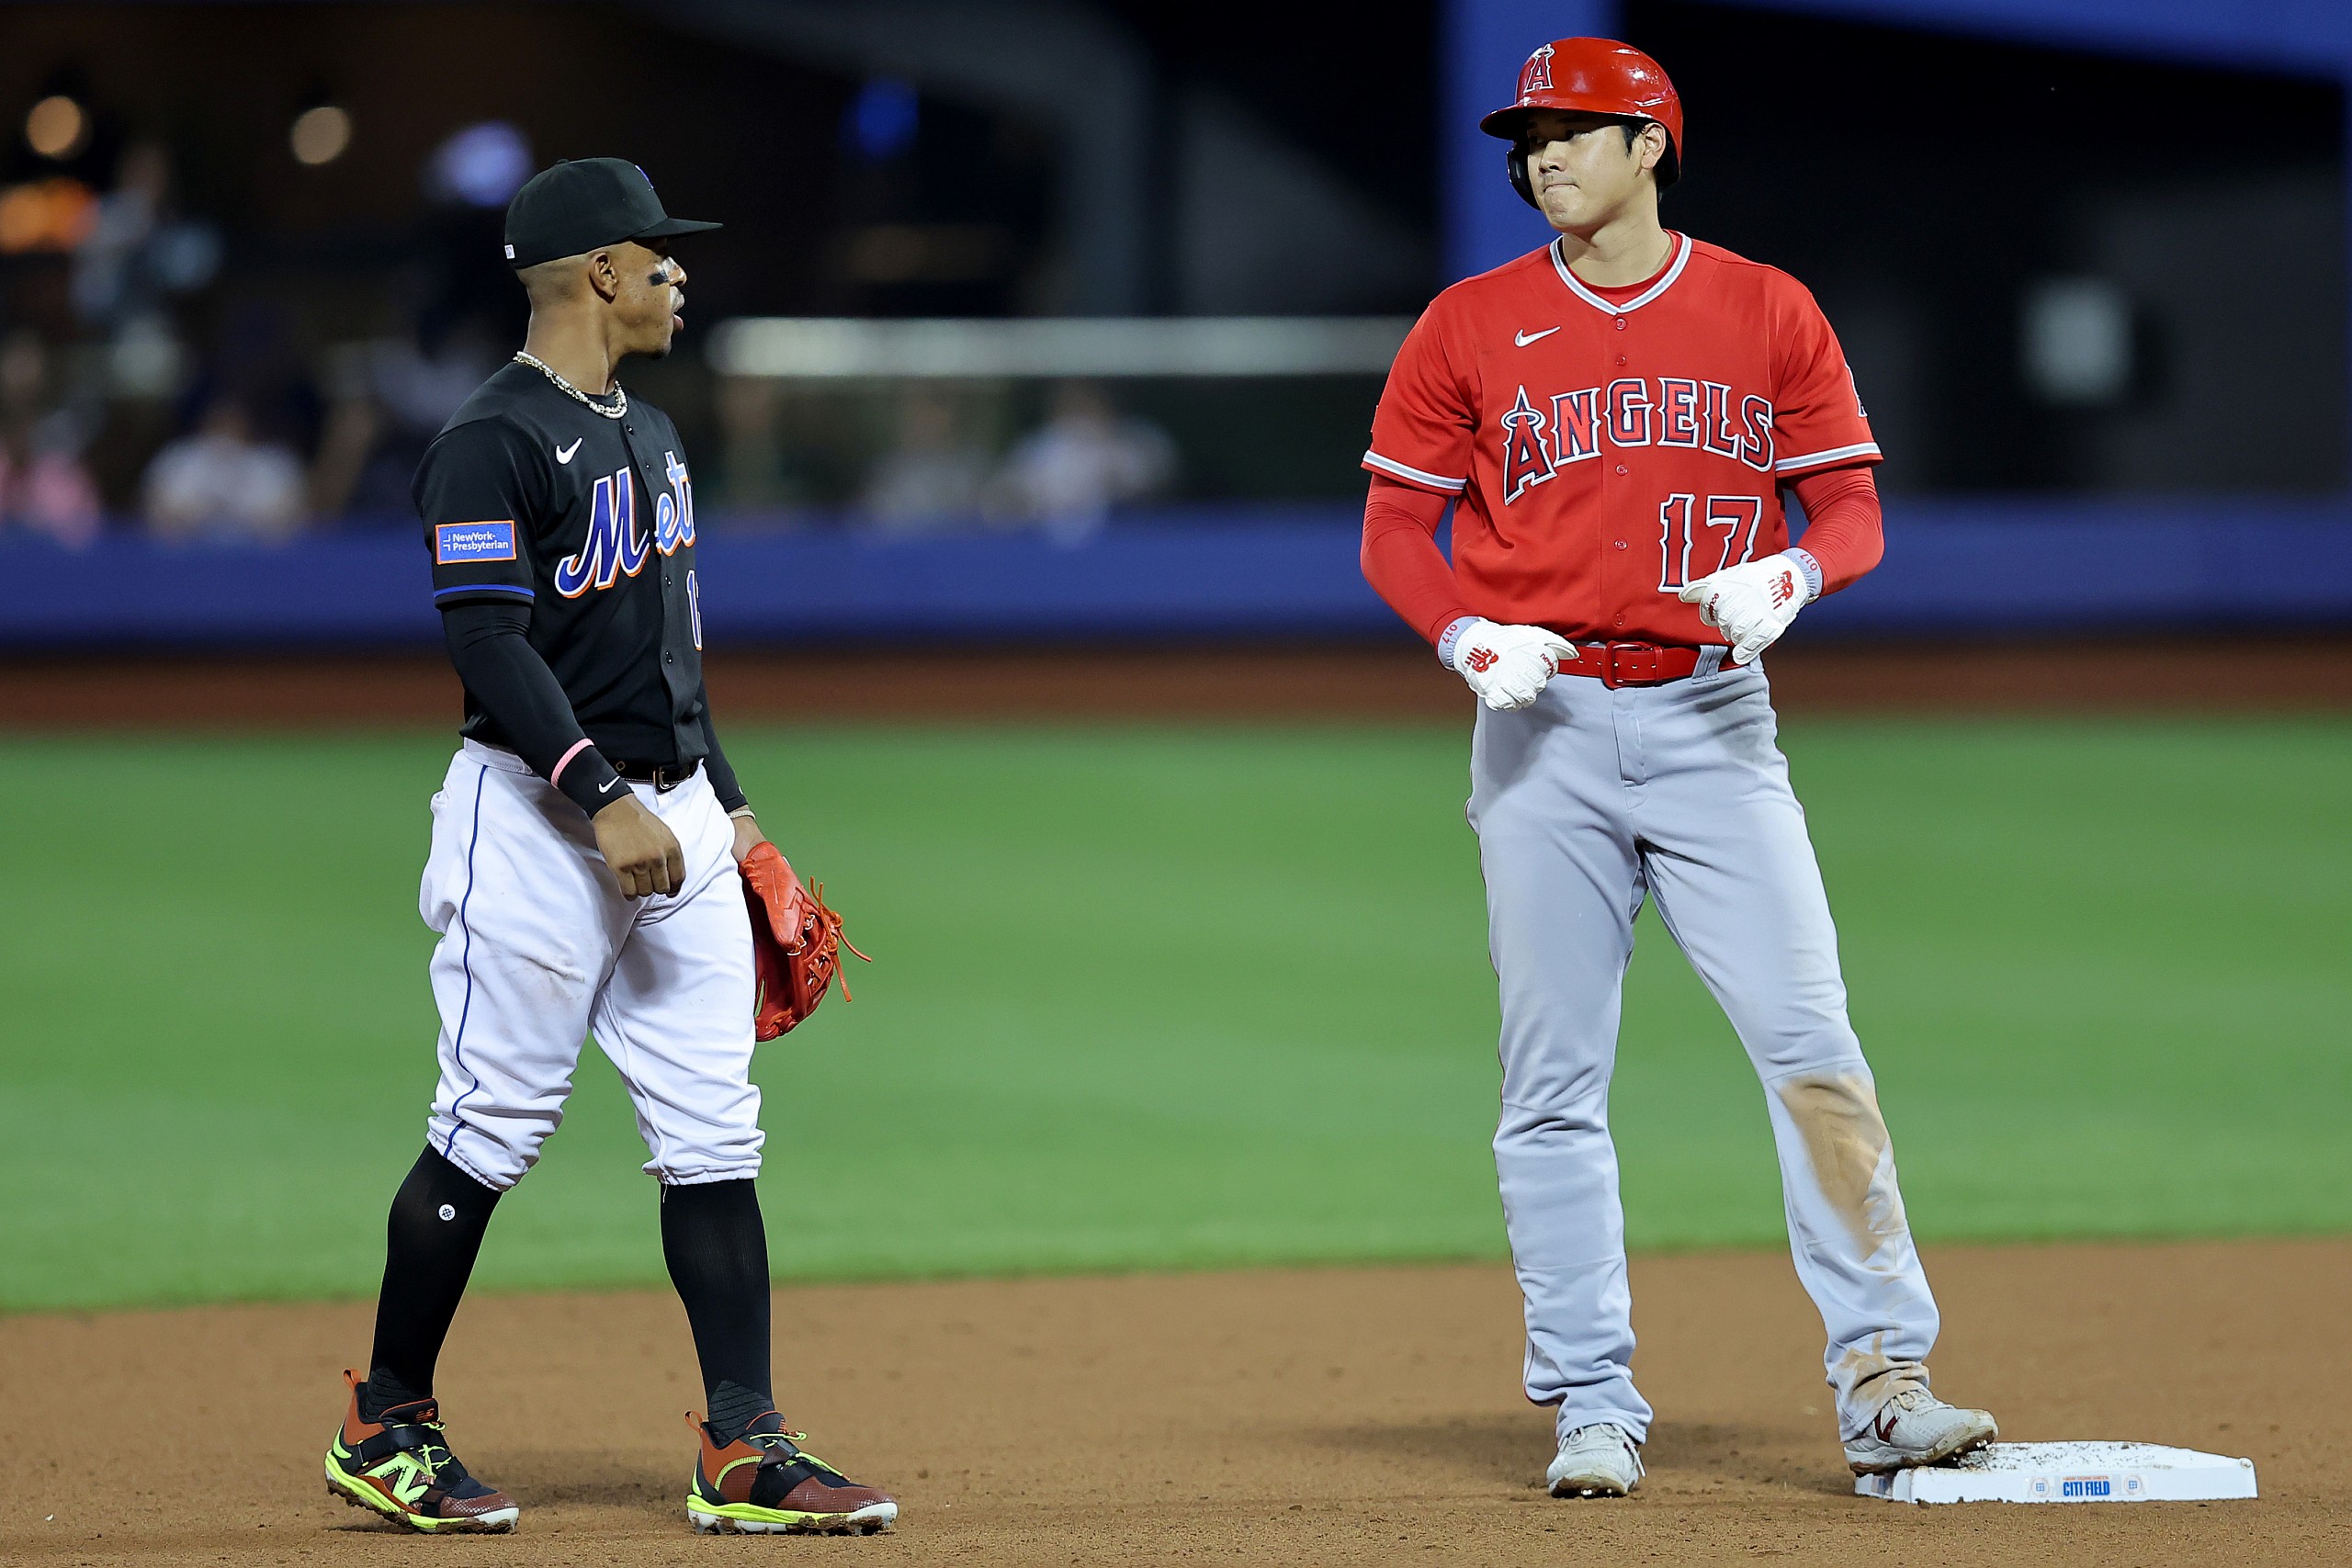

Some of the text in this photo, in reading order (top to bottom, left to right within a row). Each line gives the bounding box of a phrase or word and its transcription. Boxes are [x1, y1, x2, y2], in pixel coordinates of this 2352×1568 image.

[1522, 43, 1555, 94] A
[1500, 377, 1774, 506] ANGELS
[554, 450, 696, 598] Met
[452, 531, 496, 542] NewYork-
[452, 540, 509, 552] Presbyterian
[1657, 492, 1762, 593] 17
[1799, 553, 1818, 571] 017
[1442, 624, 1458, 644] 017
[2063, 1481, 2110, 1496] CITI FIELD
